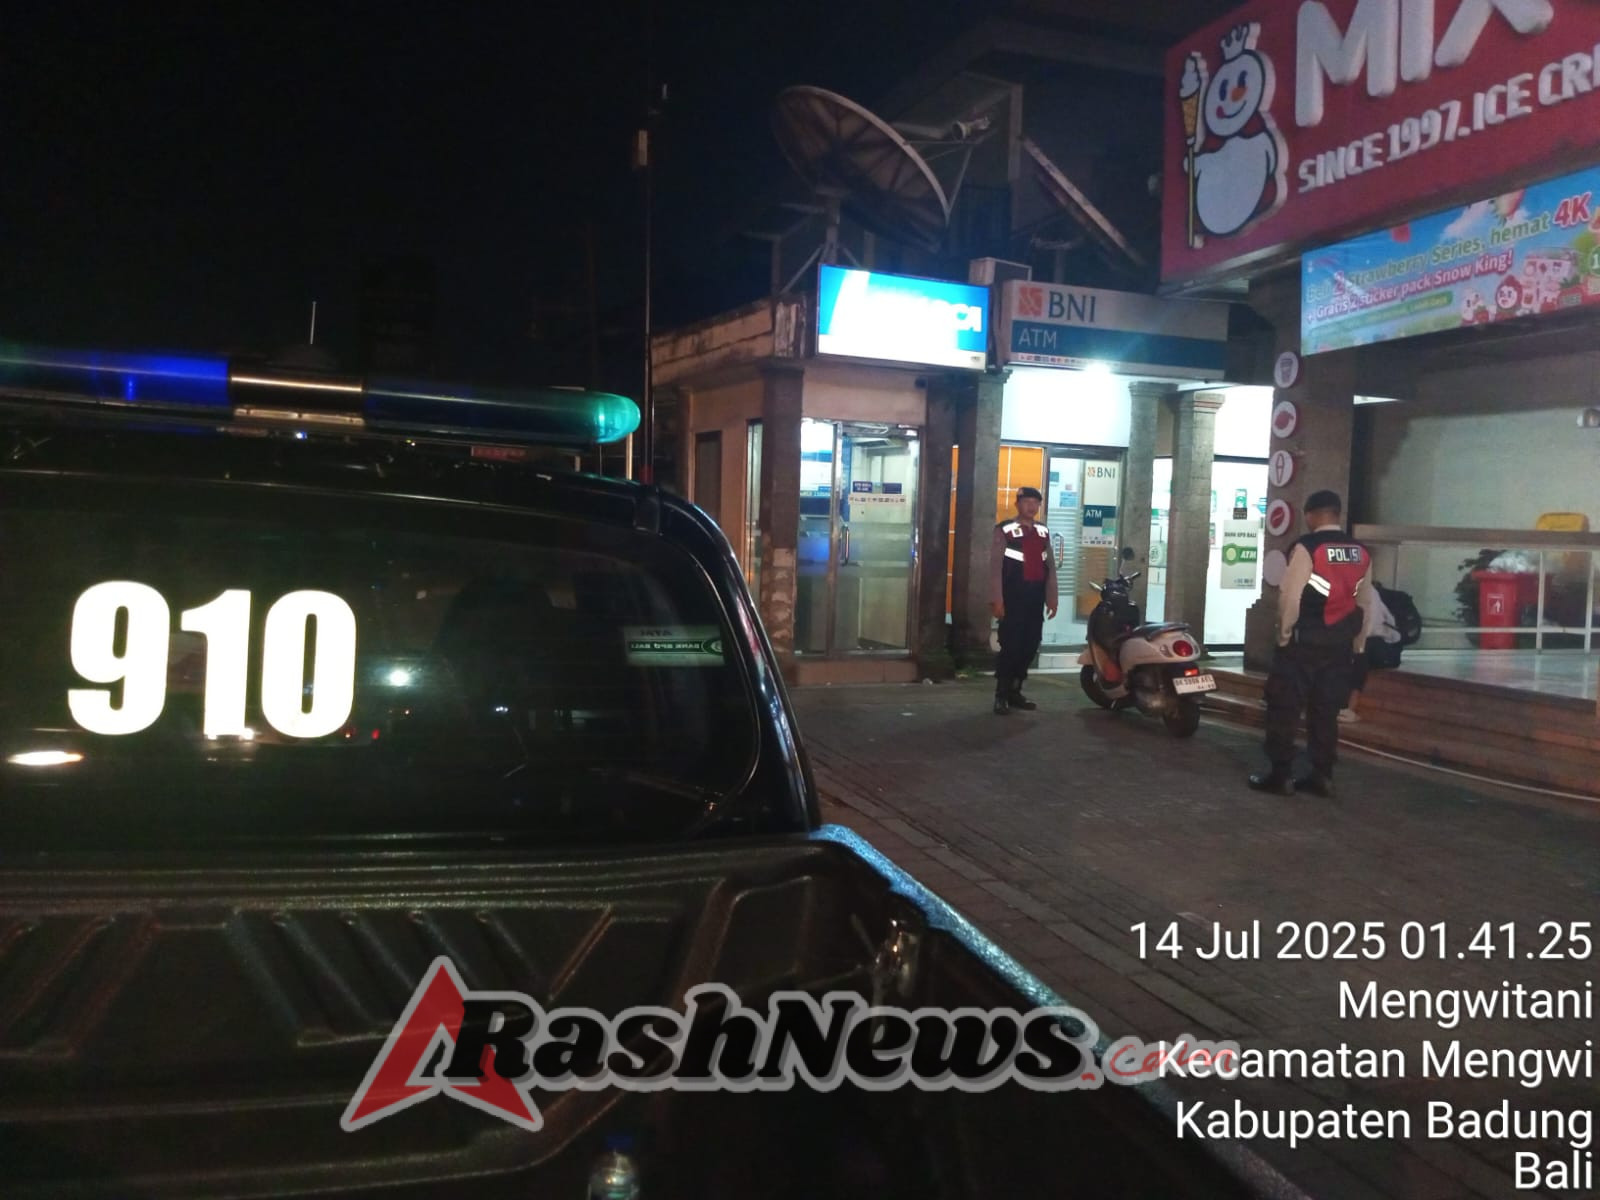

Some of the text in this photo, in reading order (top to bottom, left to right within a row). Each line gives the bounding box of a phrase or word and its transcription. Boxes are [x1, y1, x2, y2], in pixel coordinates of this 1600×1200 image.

[1298, 43, 1600, 193] SINCE 1997. ICE CR
[1491, 213, 1550, 247] hemat
[1553, 192, 1591, 228] 4K
[1316, 297, 1349, 319] Gratis
[1401, 272, 1431, 299] pack
[1433, 264, 1473, 287] Snow
[1475, 248, 1513, 275] King!
[1048, 290, 1096, 323] BNI
[1018, 327, 1057, 350] ATM
[1096, 466, 1116, 479] BNI
[1085, 509, 1102, 518] ATM
[1240, 550, 1257, 559] ATM
[68, 580, 356, 738] 910
